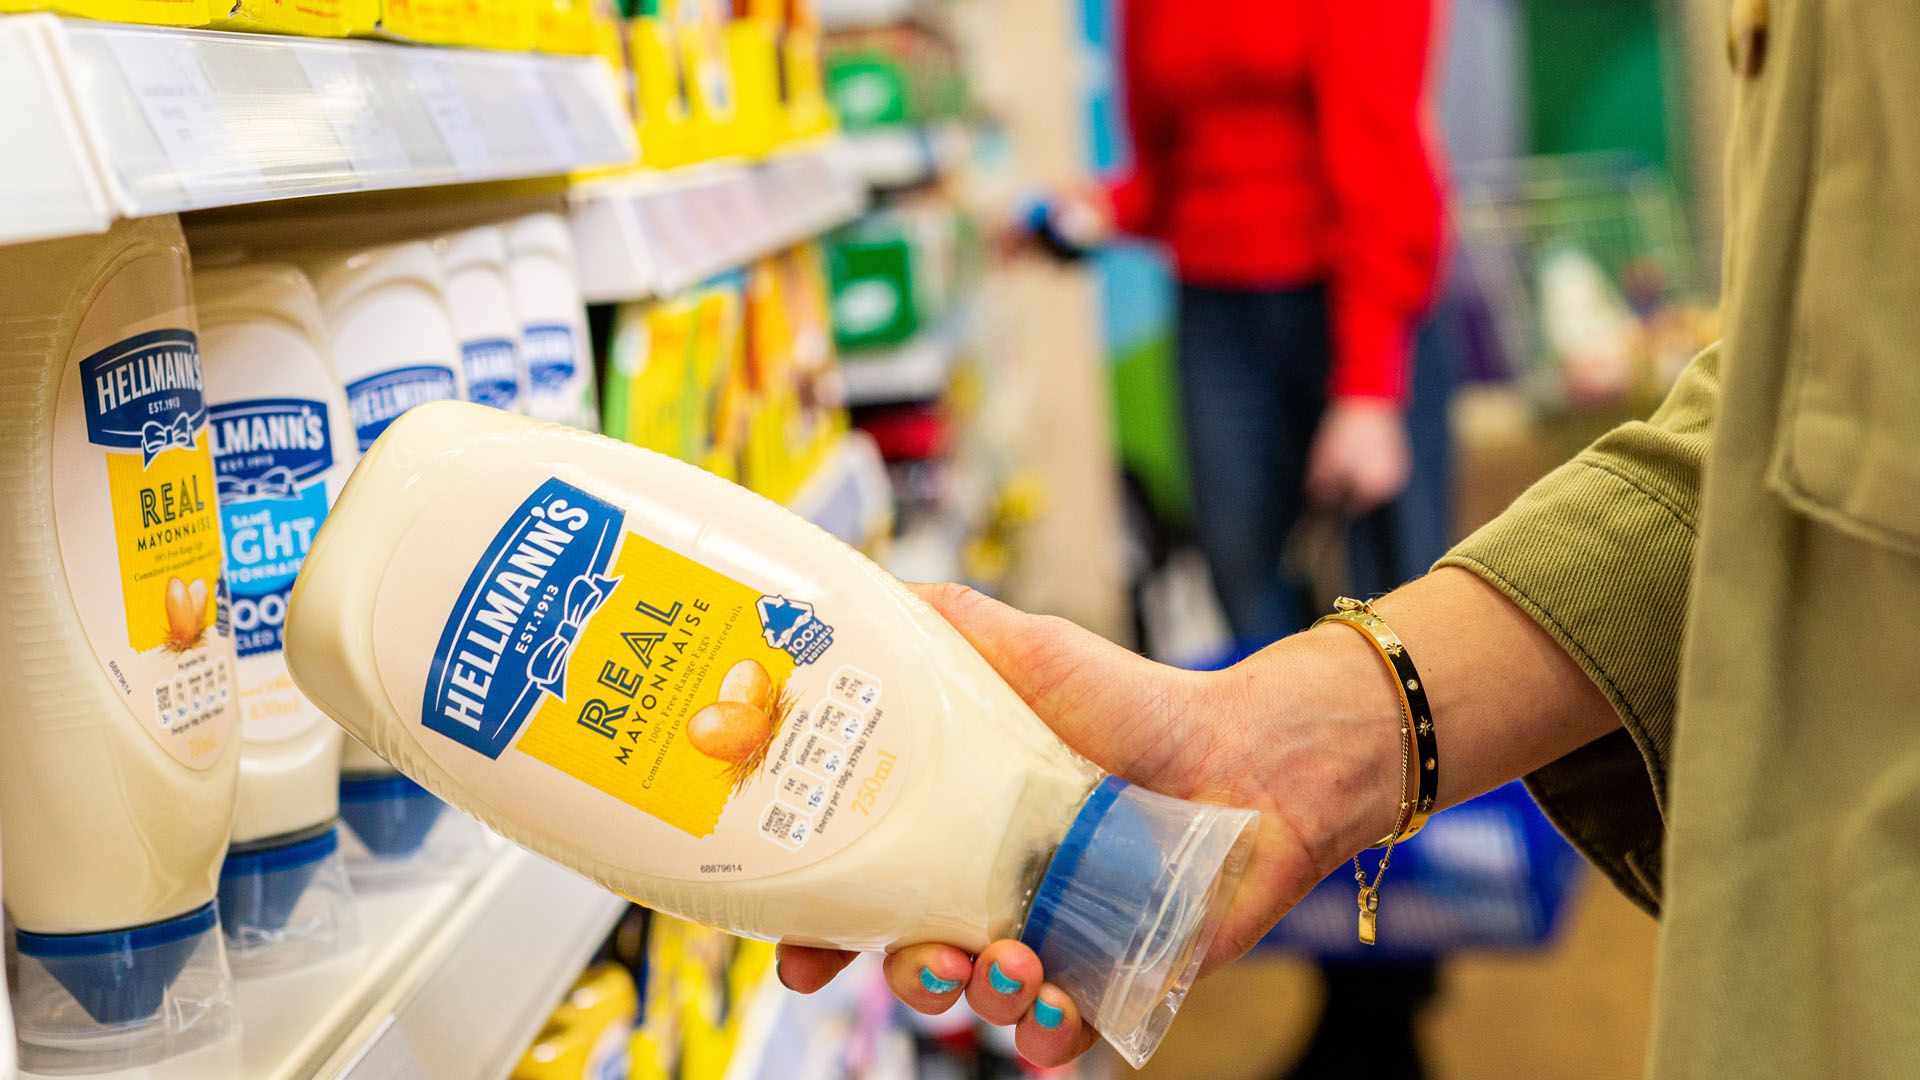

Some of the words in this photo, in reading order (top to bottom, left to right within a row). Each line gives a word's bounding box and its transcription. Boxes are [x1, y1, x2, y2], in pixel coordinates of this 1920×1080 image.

[96, 343, 203, 415] HELLMANN'S
[208, 404, 325, 457] LMANN'S
[140, 475, 204, 528] REAL
[136, 515, 211, 553] MAYONNAISE
[231, 517, 316, 564] GHT
[444, 498, 589, 731] HELLMANN'S
[515, 584, 560, 655] EST.1913
[788, 621, 823, 655] 100%
[576, 600, 684, 740] REAL
[807, 638, 832, 662] BOTTLE
[614, 598, 710, 766] MAYONNAISE
[642, 732, 675, 790] Committed
[672, 719, 681, 732] to
[678, 662, 712, 719] sustainably
[708, 622, 732, 661] sourced
[730, 604, 743, 623] oils
[648, 717, 666, 744] 100%
[661, 695, 679, 718] Free
[674, 660, 697, 693] Range
[691, 634, 711, 658] Eggs
[836, 676, 849, 691] Salt
[815, 705, 833, 729] Sugars
[770, 761, 782, 775] Per
[779, 731, 797, 762] portion
[796, 735, 818, 767] Saturates
[815, 804, 836, 834] Energy
[832, 791, 842, 808] per
[864, 708, 883, 740] 724kcal
[784, 778, 796, 791] Fat
[850, 748, 897, 817] 750ml
[762, 805, 782, 832] Energy
